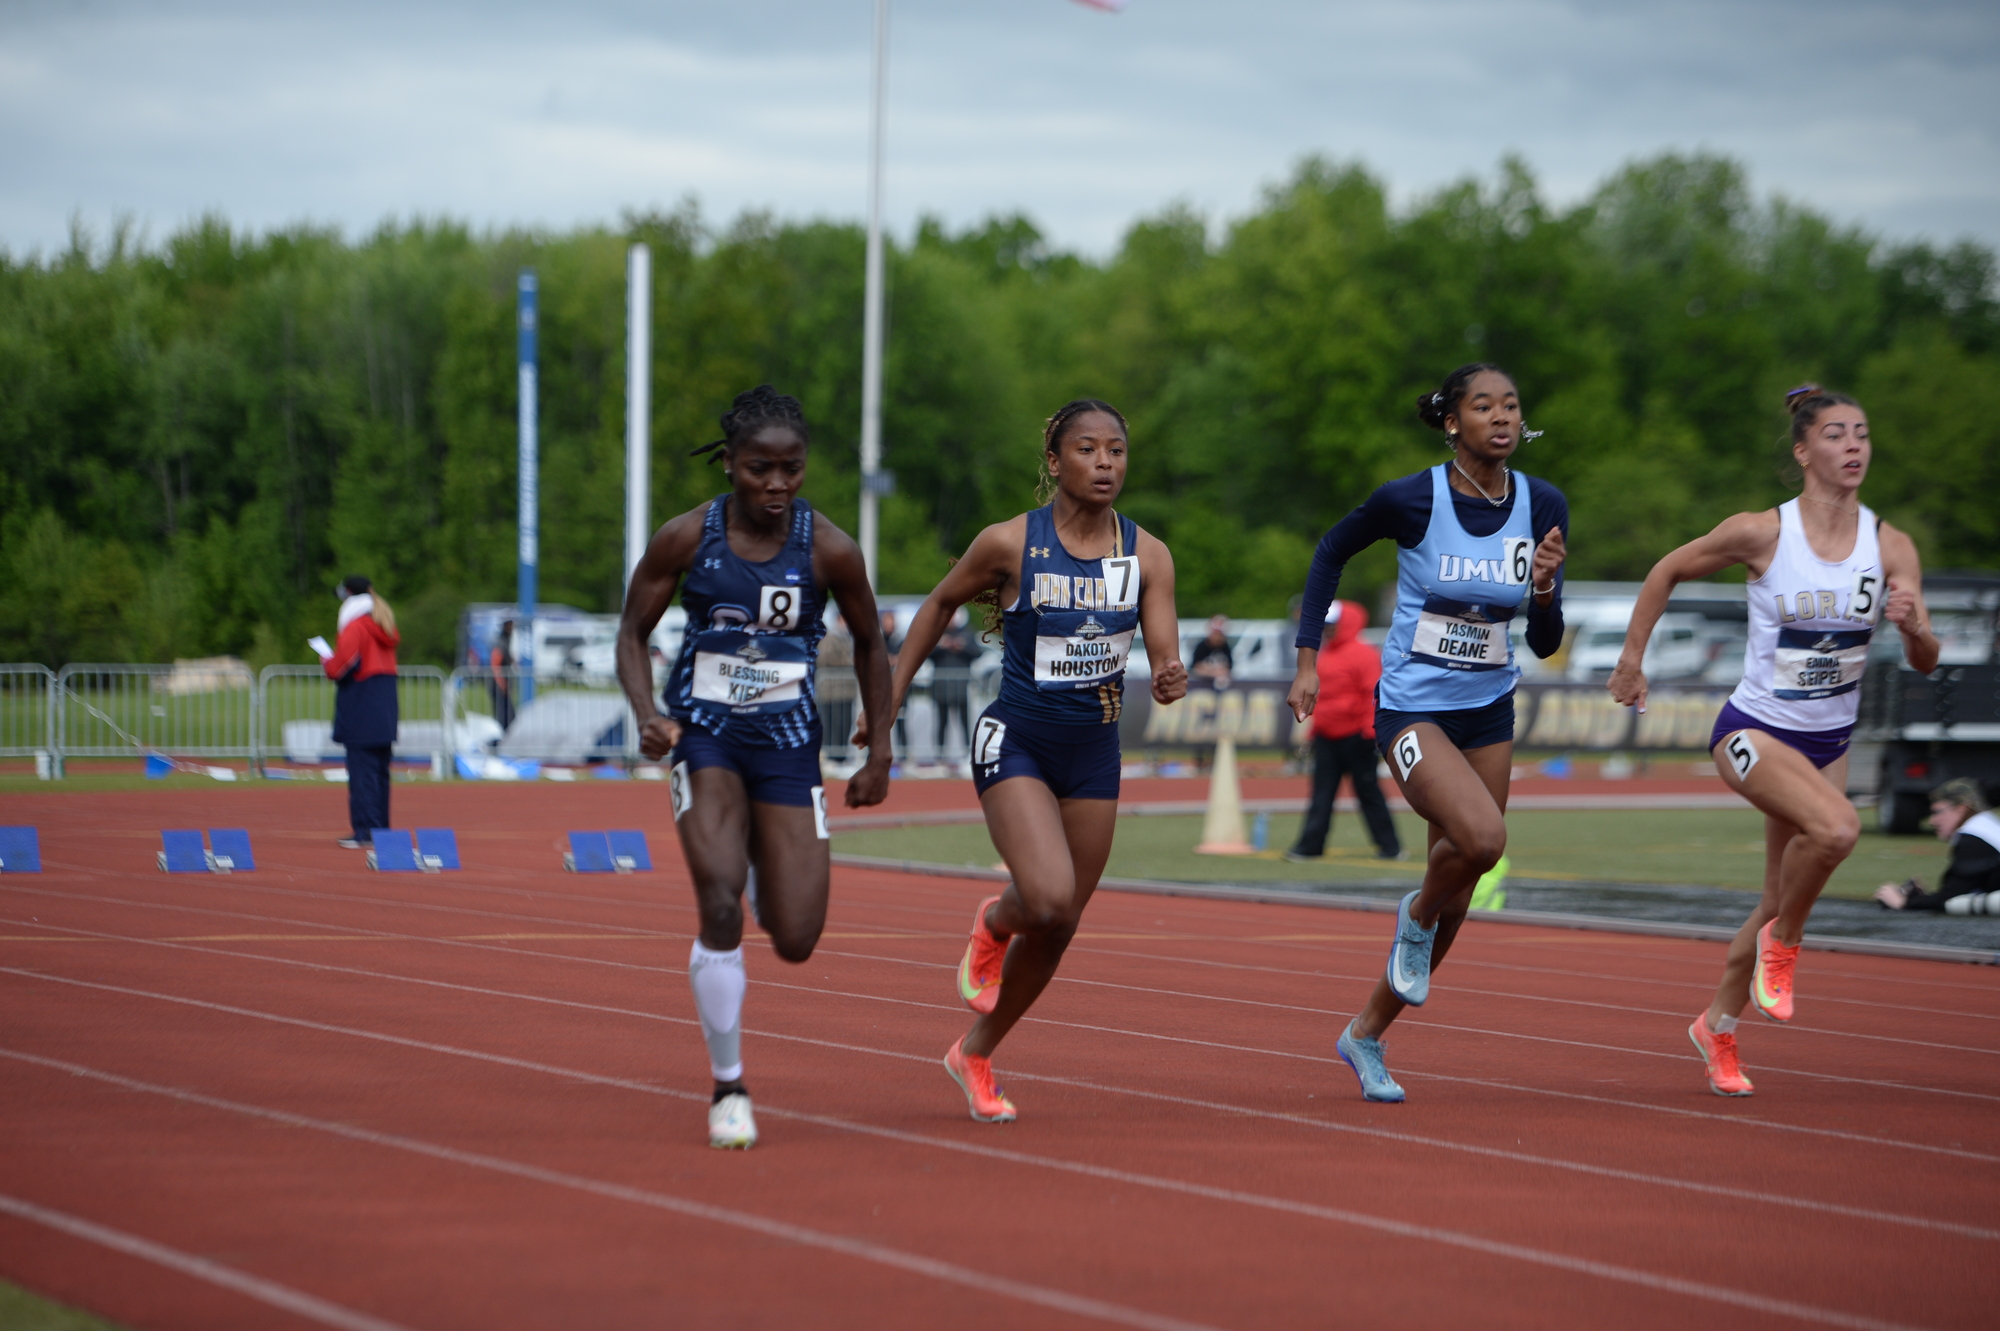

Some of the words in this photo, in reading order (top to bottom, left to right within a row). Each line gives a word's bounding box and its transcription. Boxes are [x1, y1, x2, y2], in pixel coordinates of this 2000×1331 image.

[1514, 541, 1527, 583] 6
[1030, 573, 1071, 609] JOHN
[1110, 560, 1132, 602] 7
[1854, 576, 1876, 614] 5
[767, 590, 792, 628] 8
[1774, 590, 1877, 626] LOR
[1446, 622, 1490, 640] YASMIN
[1050, 654, 1120, 677] HOUSTON
[1066, 643, 1111, 657] DAKOTA
[1438, 638, 1489, 660] DEANE
[1806, 656, 1840, 669] EMMA
[719, 663, 780, 684] BLESSING
[1797, 669, 1843, 687] SEIPEL
[980, 721, 999, 763] 7
[1399, 735, 1415, 769] 6
[1729, 736, 1751, 775] 5
